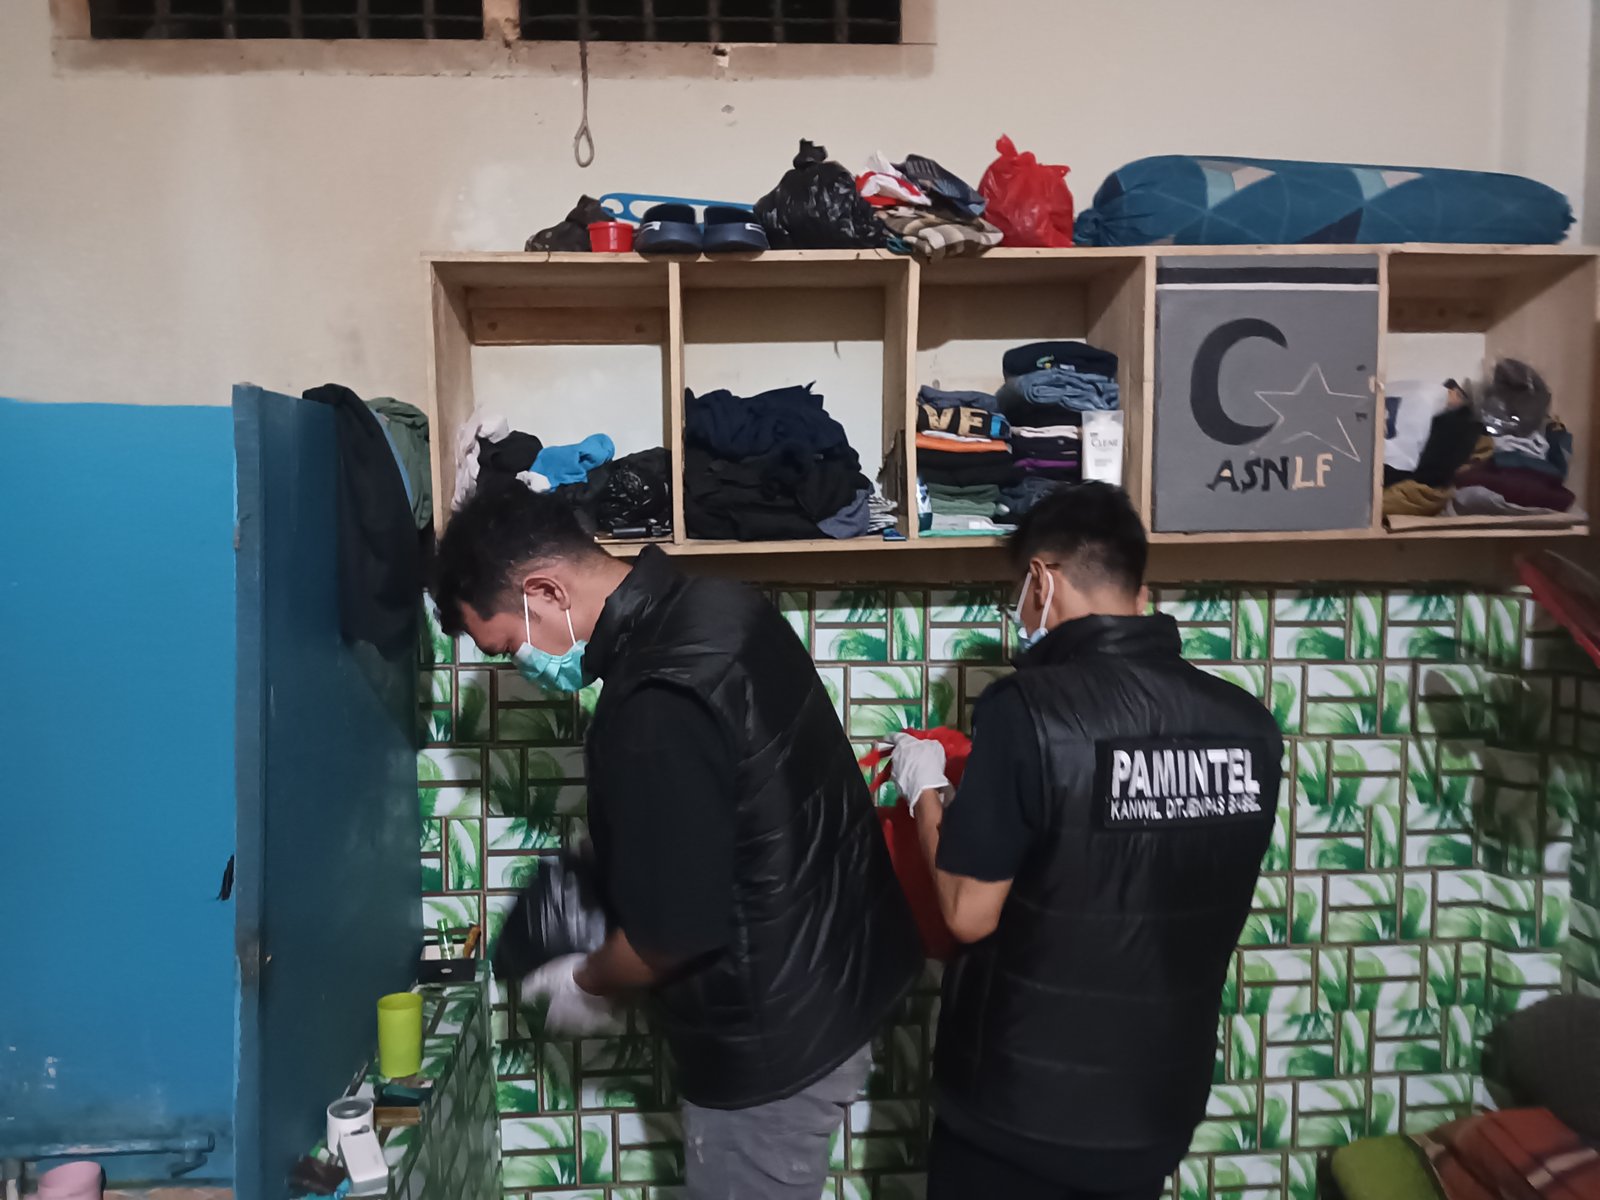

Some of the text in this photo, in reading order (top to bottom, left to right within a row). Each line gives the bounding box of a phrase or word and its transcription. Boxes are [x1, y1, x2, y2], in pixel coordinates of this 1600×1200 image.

[917, 404, 988, 438] VE
[1206, 453, 1333, 493] ASNLF
[1111, 749, 1260, 799] PAMINTEL
[1111, 799, 1162, 820] KANWIL
